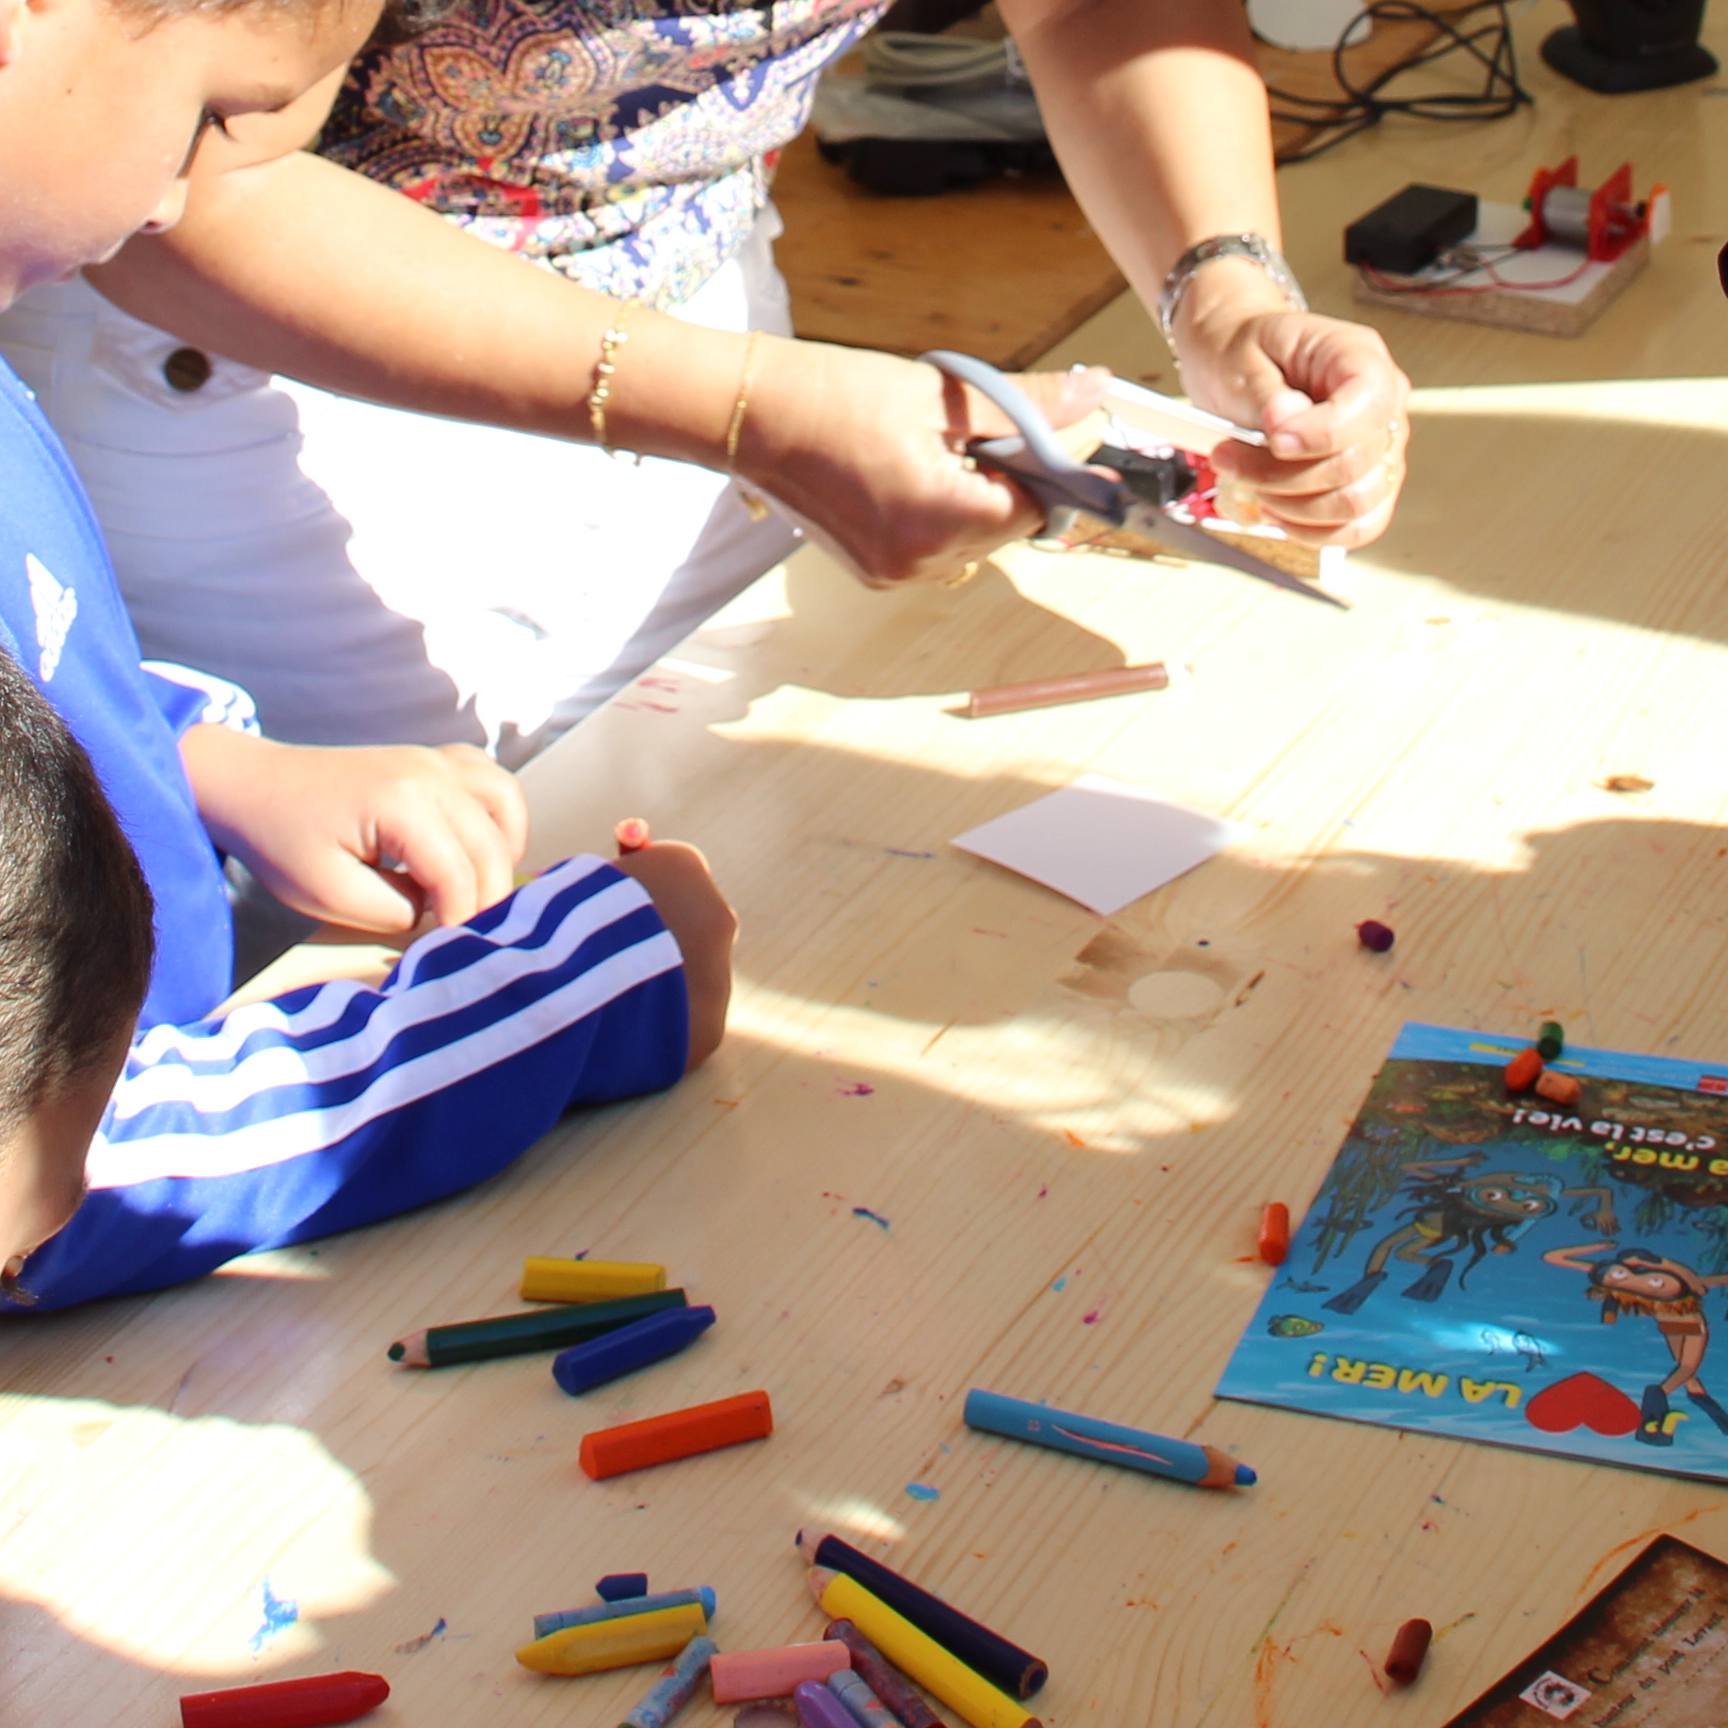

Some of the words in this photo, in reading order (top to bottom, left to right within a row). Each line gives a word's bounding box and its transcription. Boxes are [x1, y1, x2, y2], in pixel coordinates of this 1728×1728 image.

[1590, 1120, 1623, 1141] la
[1630, 1128, 1717, 1151] c'est
[1604, 1141, 1700, 1171] mer,
[1461, 1377, 1522, 1409] LA
